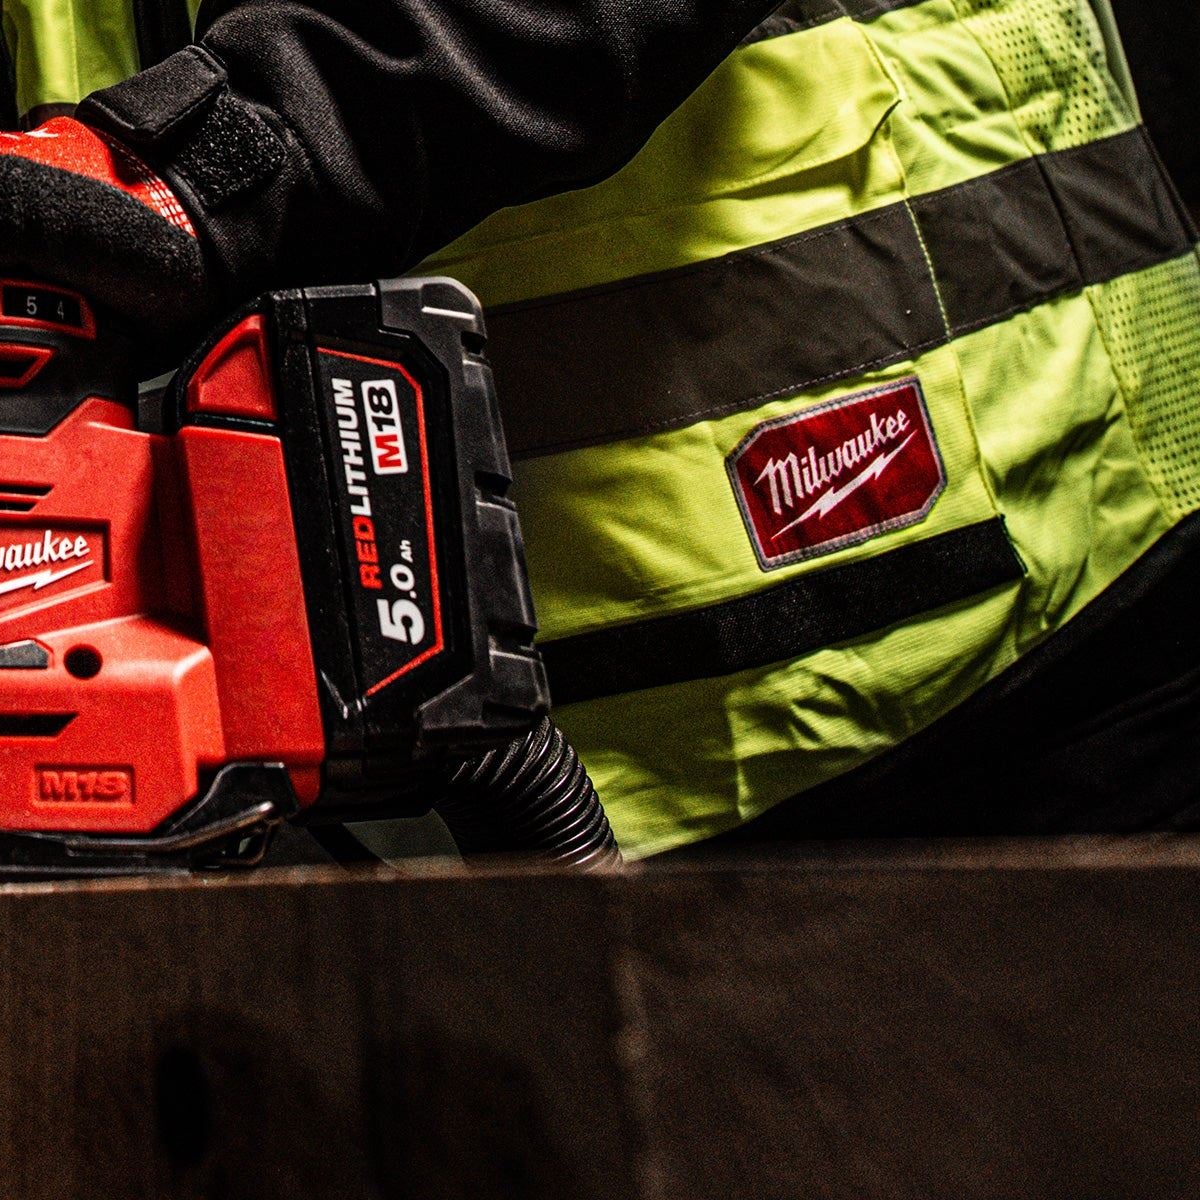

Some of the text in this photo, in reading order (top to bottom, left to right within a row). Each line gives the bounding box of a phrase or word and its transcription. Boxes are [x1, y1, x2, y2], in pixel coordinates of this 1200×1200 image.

[26, 296, 65, 320] 5 4
[368, 386, 402, 468] M18
[753, 408, 910, 515] Milwaukee
[331, 378, 383, 591] REDLITHIUM
[38, 770, 128, 802] M18
